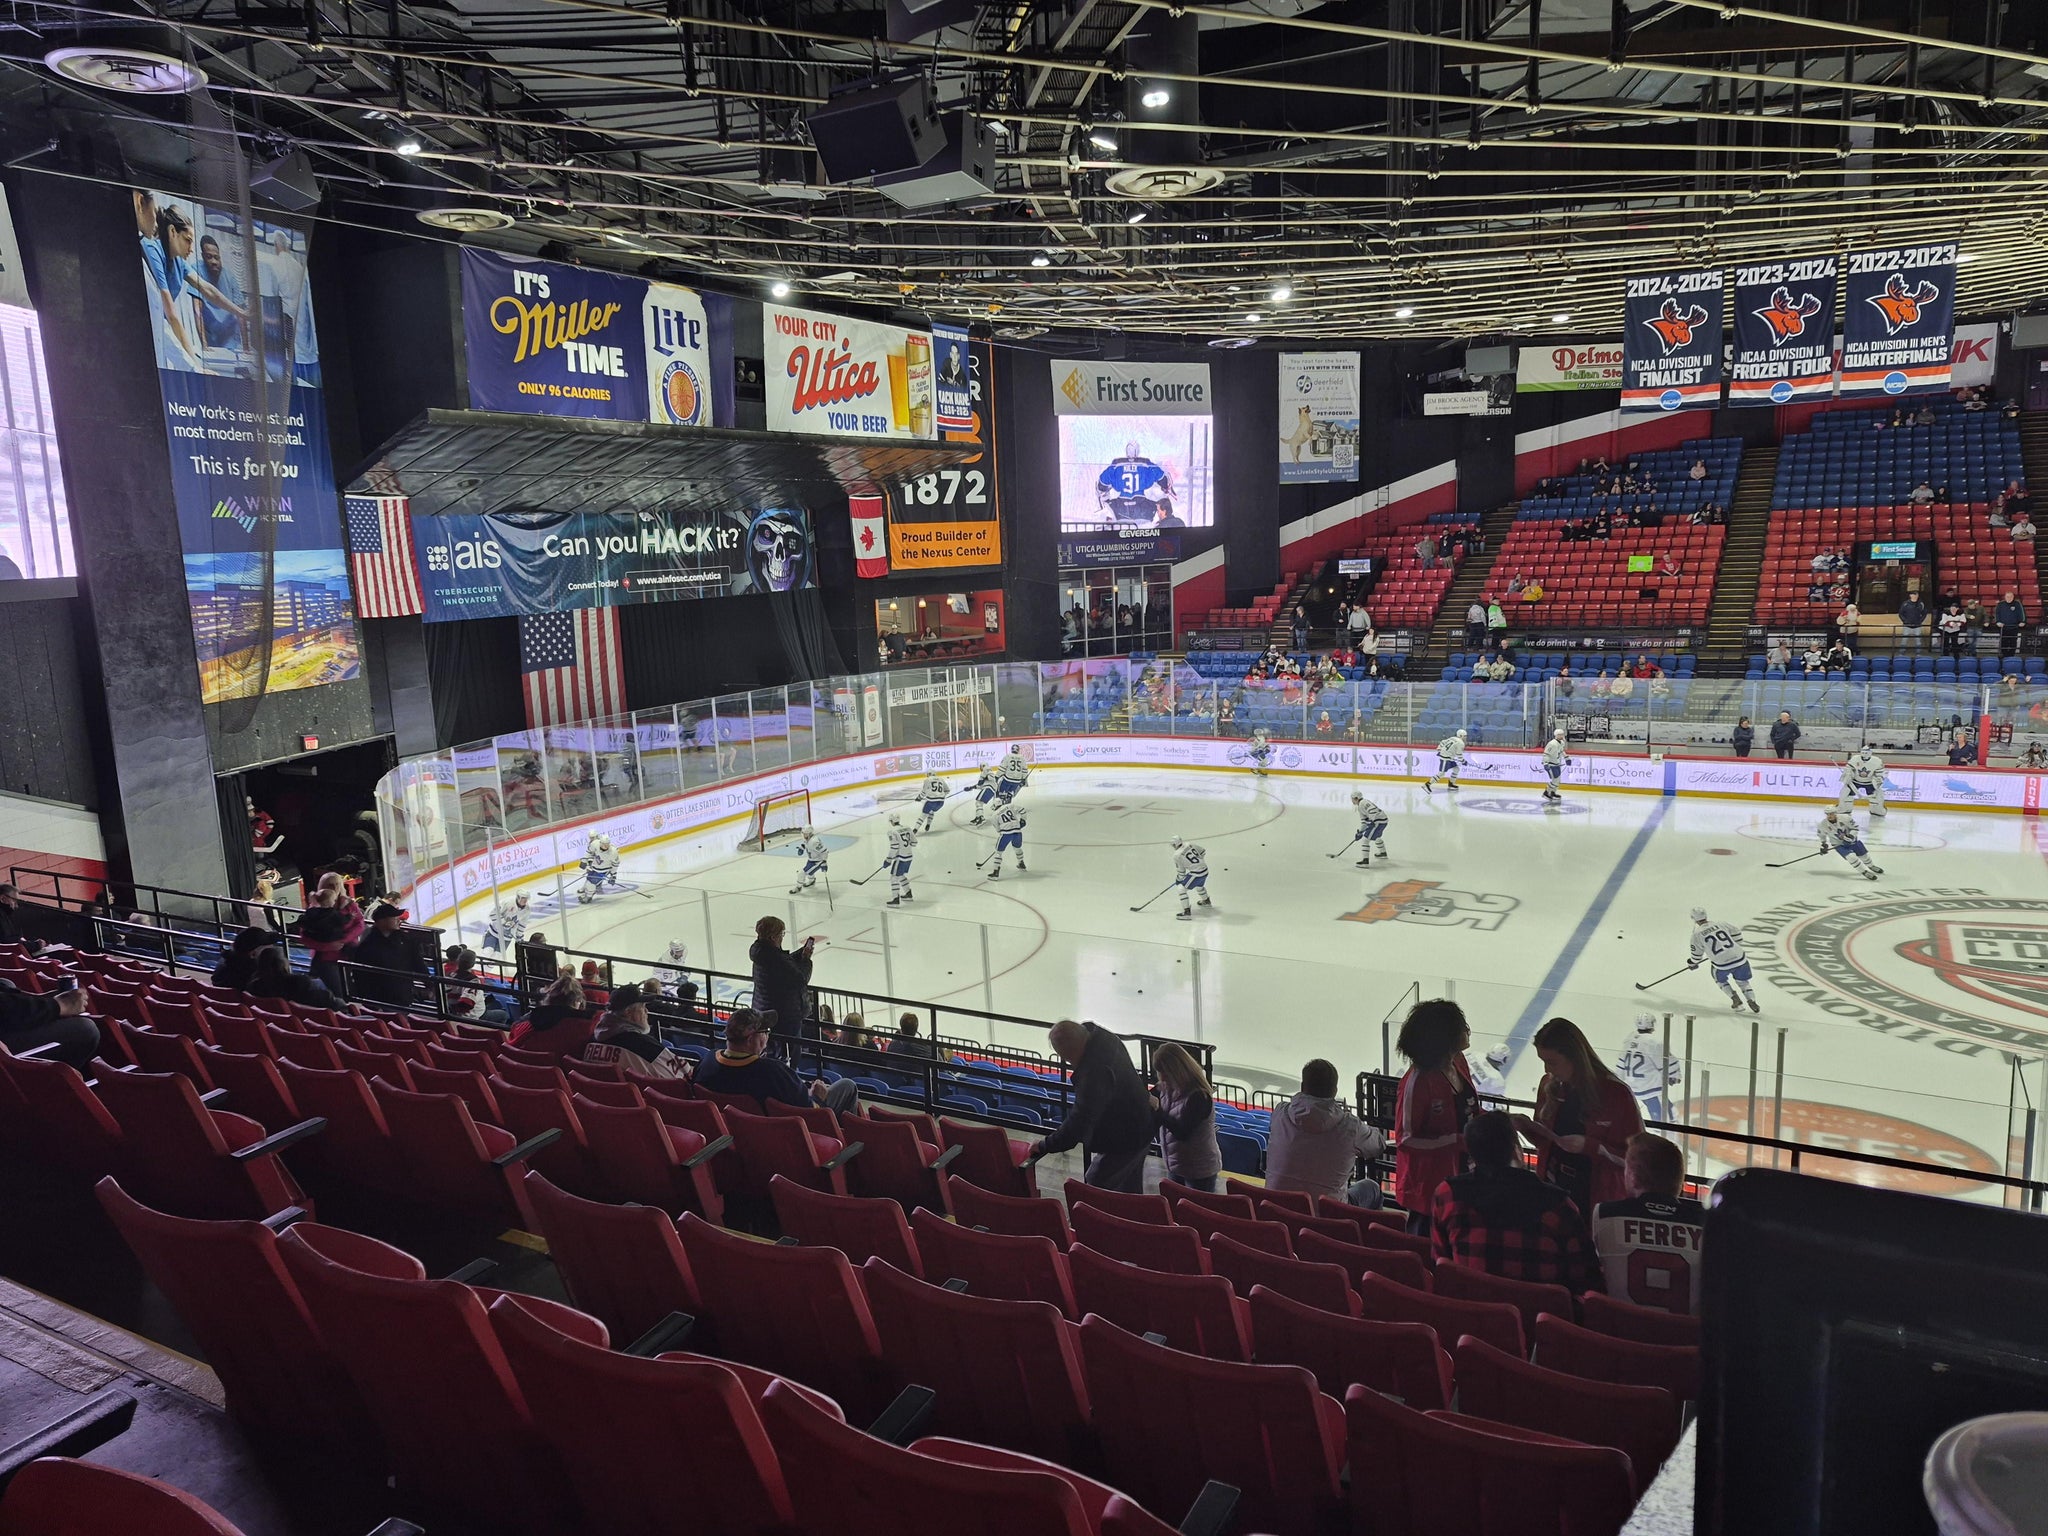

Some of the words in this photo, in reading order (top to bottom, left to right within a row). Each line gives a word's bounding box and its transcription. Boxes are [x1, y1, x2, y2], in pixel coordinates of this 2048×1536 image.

[1850, 244, 1957, 274] 2022-2023
[1736, 258, 1837, 287] 2023-2024
[513, 269, 551, 299] IT'S
[1627, 270, 1724, 298] 2024-2025
[490, 296, 621, 363] Miller
[650, 305, 701, 357] Lite
[773, 313, 809, 338] YOUR
[812, 321, 838, 342] CITY
[1846, 342, 1869, 353] NCAA
[1871, 339, 1908, 351] DIVISION
[1909, 338, 1919, 348] III
[1920, 335, 1946, 347] MEN'S
[1631, 359, 1657, 371] NCAA
[1659, 355, 1701, 370] DIVISION
[1703, 354, 1713, 366] III
[1740, 350, 1767, 363] NCAA
[1769, 346, 1814, 362] DIVISION
[1815, 345, 1825, 358] III
[1844, 347, 1948, 368] QUARTERFINALS
[786, 337, 881, 414] Utica
[1638, 367, 1704, 388] FINALIST
[1733, 361, 1790, 380] FROZEN
[1792, 356, 1832, 377] FOUR
[518, 381, 547, 395] ONLY
[549, 385, 562, 397] 96
[562, 386, 611, 402] CALORIES
[1096, 376, 1138, 402] First
[1141, 377, 1203, 402] Source
[168, 402, 196, 417] New
[199, 405, 235, 421] York's
[1470, 408, 1512, 416] ERSON
[828, 411, 859, 431] YOUR
[862, 416, 888, 434] BEER
[173, 425, 204, 438] most
[208, 429, 254, 442] modern
[190, 455, 224, 475] This
[227, 457, 240, 475] is
[242, 457, 267, 480] for
[270, 460, 299, 479] You
[904, 470, 987, 505] 1872
[1121, 472, 1140, 494] 31
[543, 535, 590, 558] Can
[595, 535, 638, 561] you
[640, 526, 714, 555] HACK
[715, 526, 740, 550] it?
[901, 531, 933, 543] Proud
[935, 530, 973, 541] Builder
[975, 529, 987, 540] of
[455, 531, 502, 570] ais
[901, 548, 919, 559] the
[921, 547, 954, 559] Nexus
[956, 546, 991, 556] Center
[1075, 545, 1096, 554] UTICA
[1096, 543, 1131, 553] PLUMBING
[1131, 541, 1155, 551] SUPPLY
[567, 581, 597, 591] Connect
[597, 579, 620, 589] Today!
[637, 572, 722, 586] www.ainfosec.com/utica
[434, 585, 503, 597] CYBERSECURITY
[442, 595, 498, 606] INNOVATORS
[1535, 639, 1546, 647] do
[1641, 639, 1652, 647] do
[925, 751, 951, 760] SCORE
[1100, 746, 1122, 754] QUEST
[1318, 752, 1365, 766] AQUA
[925, 759, 952, 768] YOURS
[1009, 760, 1023, 773] 35
[1567, 765, 1607, 777] urning
[1609, 760, 1651, 778] Stone
[1688, 770, 1750, 785] Michelob
[1765, 775, 1828, 788] ULTRA
[930, 782, 944, 793] 56
[2028, 777, 2037, 807] CCM
[665, 807, 685, 820] OTTER
[684, 803, 700, 815] LAKE
[699, 797, 721, 811] STATION
[479, 851, 512, 872] NIA'S
[484, 868, 501, 880] (35)
[1741, 900, 1829, 936] BANK
[1827, 887, 1990, 904] CENTER
[1704, 930, 1735, 956] 29
[662, 972, 674, 980] 57
[583, 1043, 622, 1063] FIELDS
[1624, 1050, 1646, 1079] 42
[1644, 1202, 1678, 1213] CCM
[1623, 1220, 1702, 1251] FERGY
